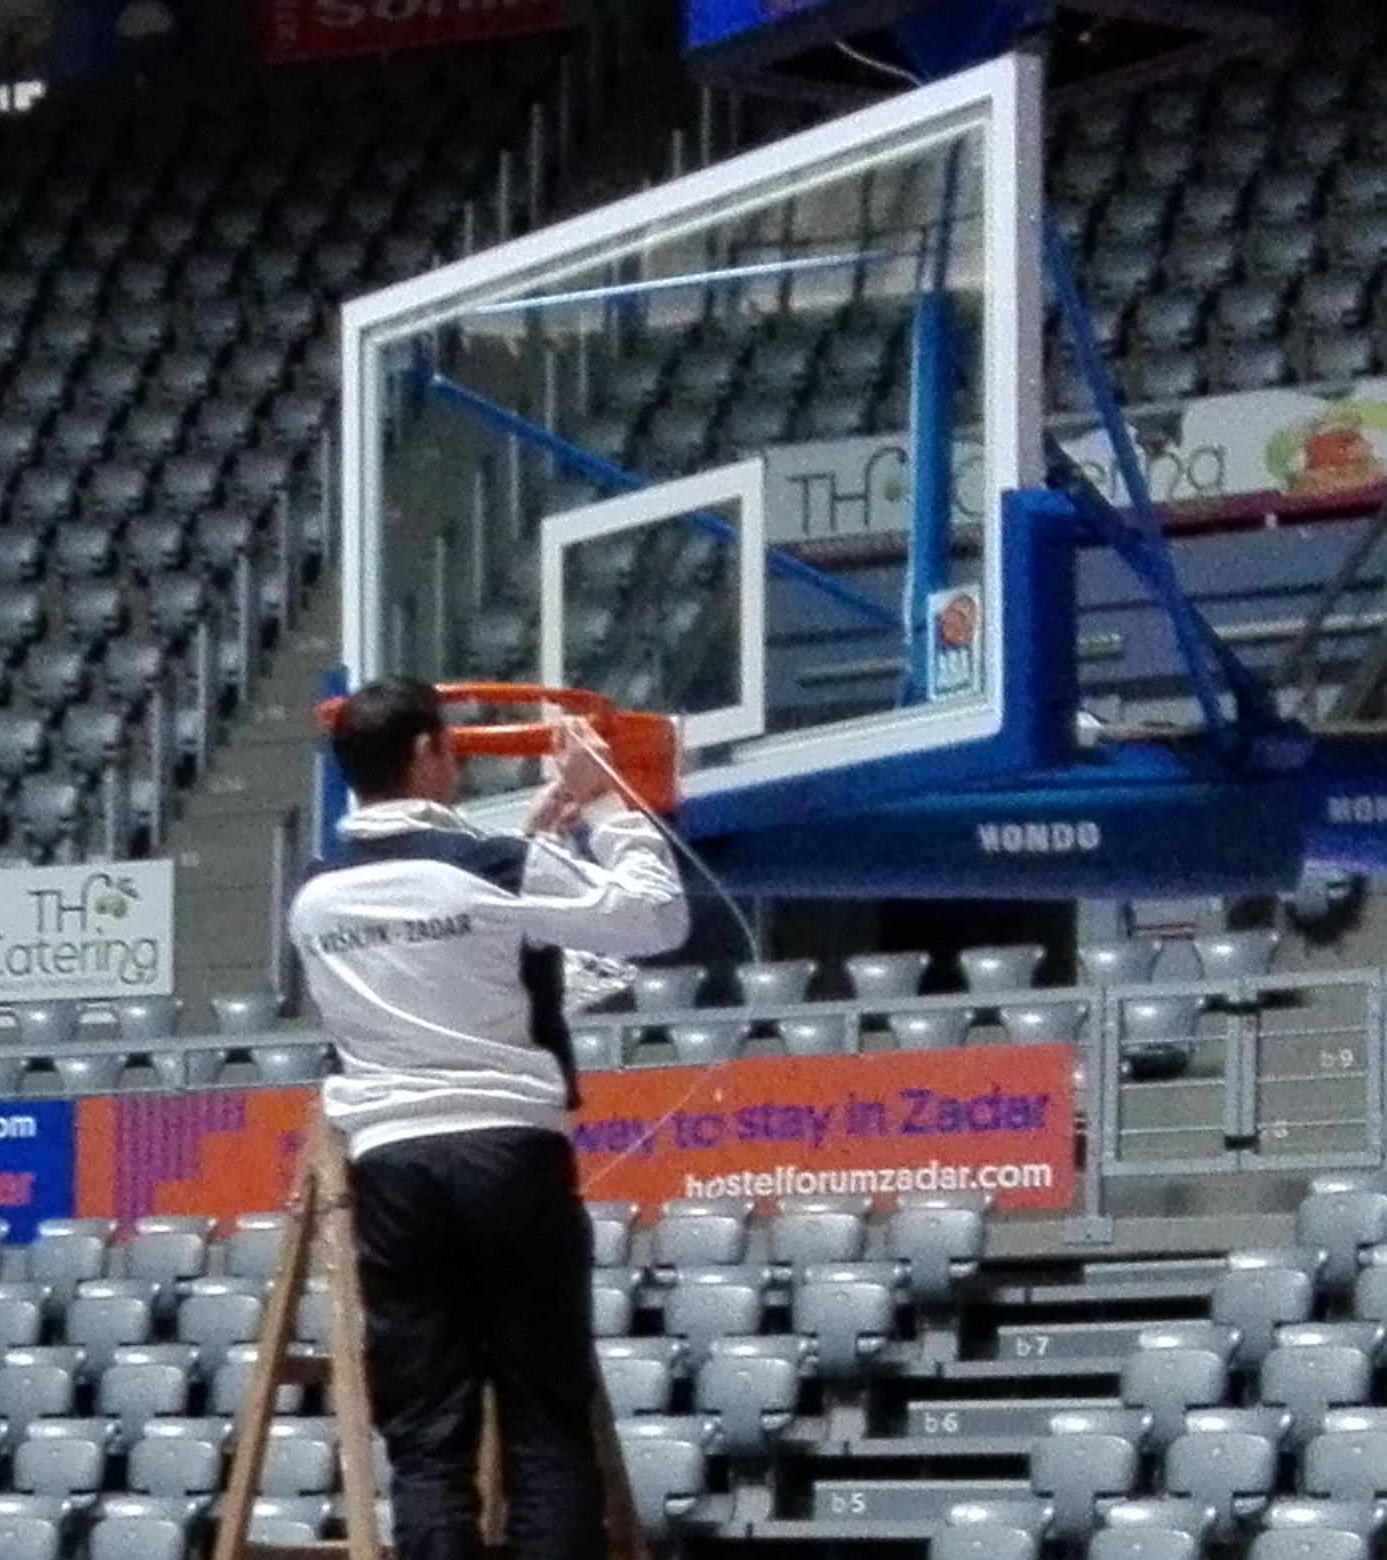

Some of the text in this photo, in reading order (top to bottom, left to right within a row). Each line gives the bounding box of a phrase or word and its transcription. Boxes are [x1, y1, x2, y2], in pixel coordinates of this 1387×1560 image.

[673, 1112, 724, 1150] to
[736, 1100, 832, 1148] stay
[846, 1093, 888, 1137] in
[900, 1085, 1053, 1137] Zadar
[685, 1159, 1053, 1199] hostelforumzadar.com
